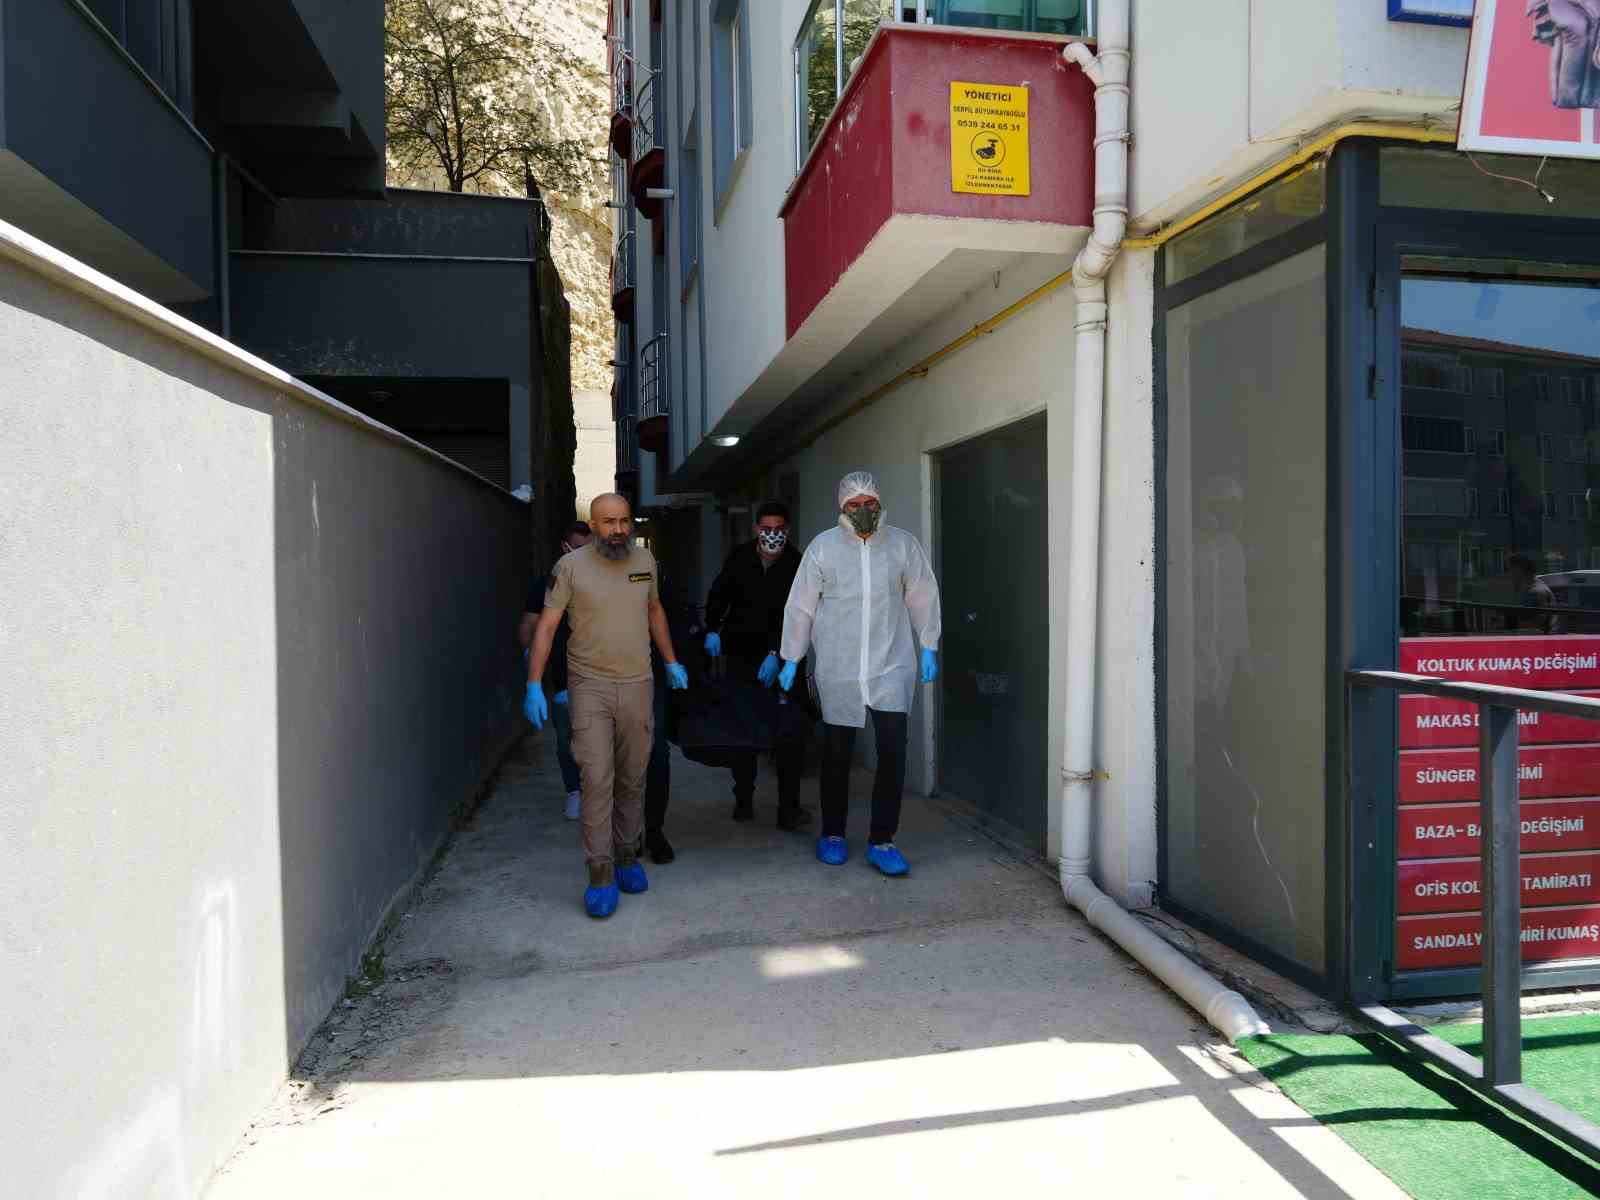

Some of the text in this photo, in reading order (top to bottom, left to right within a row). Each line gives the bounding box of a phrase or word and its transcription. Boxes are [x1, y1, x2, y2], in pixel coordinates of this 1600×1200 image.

[964, 89, 1012, 102] YÖNETİCİ
[1416, 652, 1597, 675] KOLTUK KUMAŞ DEĞİŞİMİ
[1416, 713, 1472, 729] MAKAS
[1416, 767, 1476, 784] SÜNGER
[1520, 815, 1585, 837] DEĞİŞİMİ
[1414, 878, 1449, 896] OFİS
[1523, 872, 1592, 891] TAMİRATI
[1547, 923, 1600, 942] KUMAŞ
